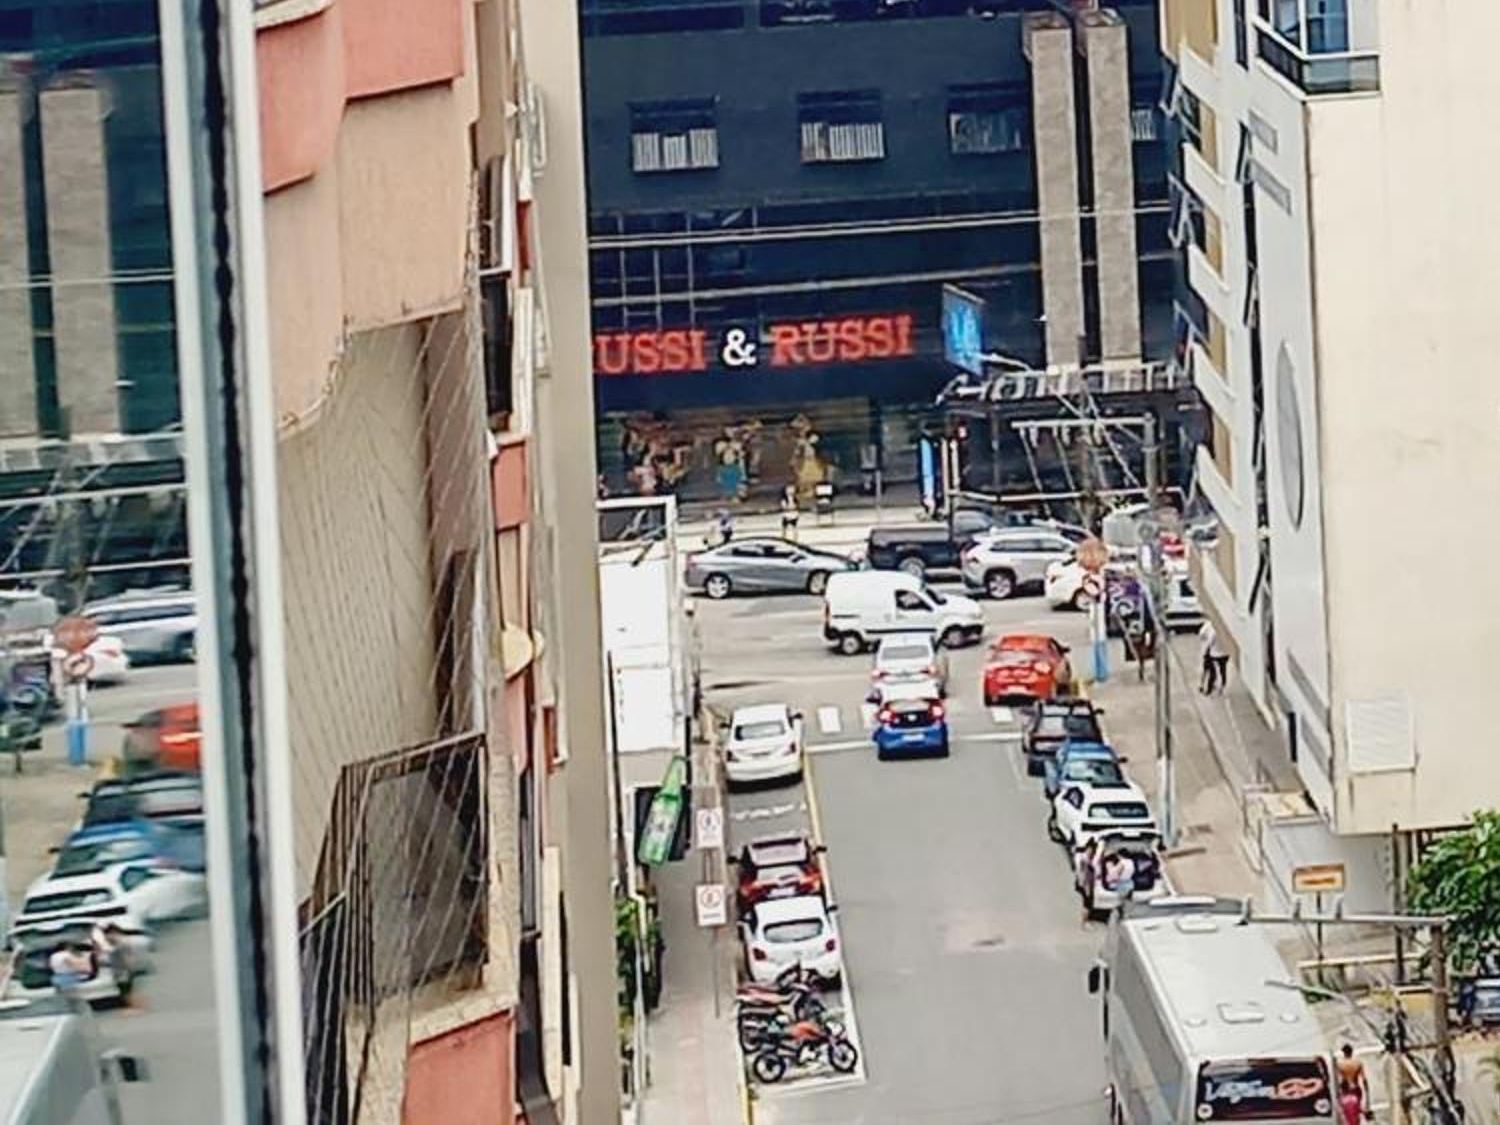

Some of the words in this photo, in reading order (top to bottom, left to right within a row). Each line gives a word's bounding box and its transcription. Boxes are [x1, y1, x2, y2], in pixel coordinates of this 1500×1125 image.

[593, 330, 706, 374] USSI
[721, 328, 757, 367] &
[770, 315, 913, 365] RUSSI
